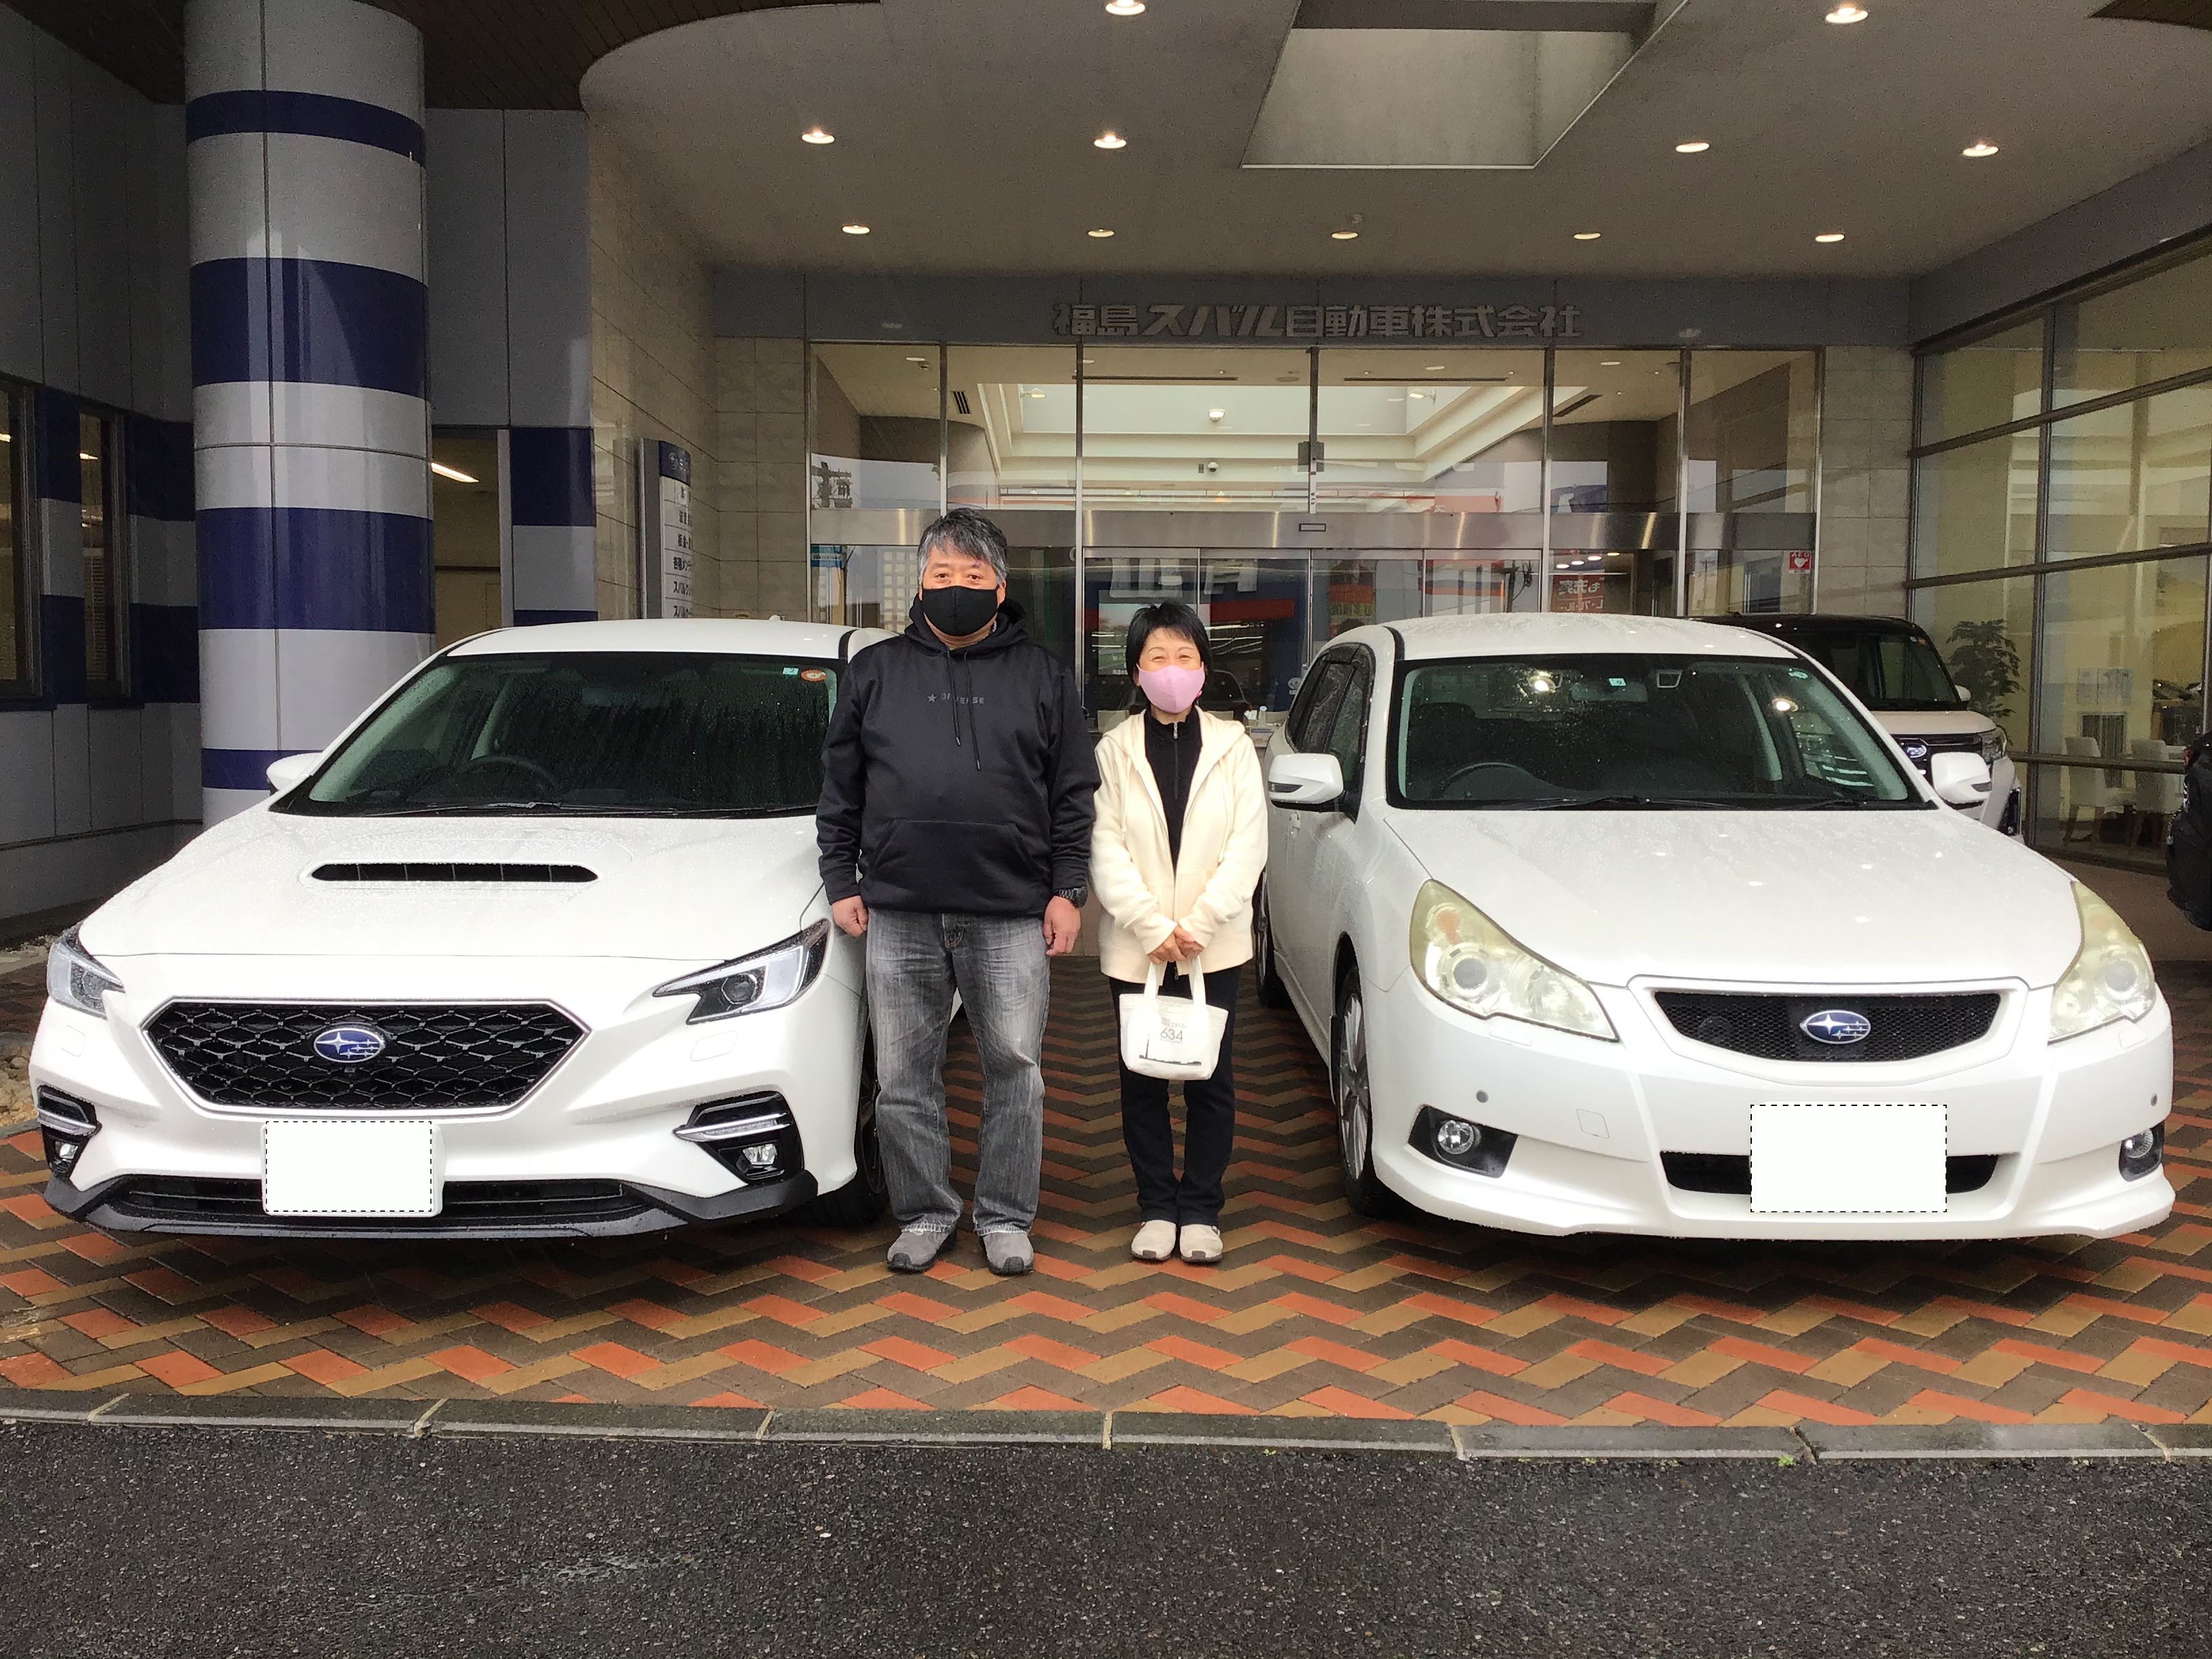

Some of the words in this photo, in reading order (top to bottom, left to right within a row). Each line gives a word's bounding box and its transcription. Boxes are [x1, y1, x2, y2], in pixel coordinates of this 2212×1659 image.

[1052, 304, 1582, 337] 福島スバル自動車株式会社
[1160, 1027, 1183, 1041] 634
